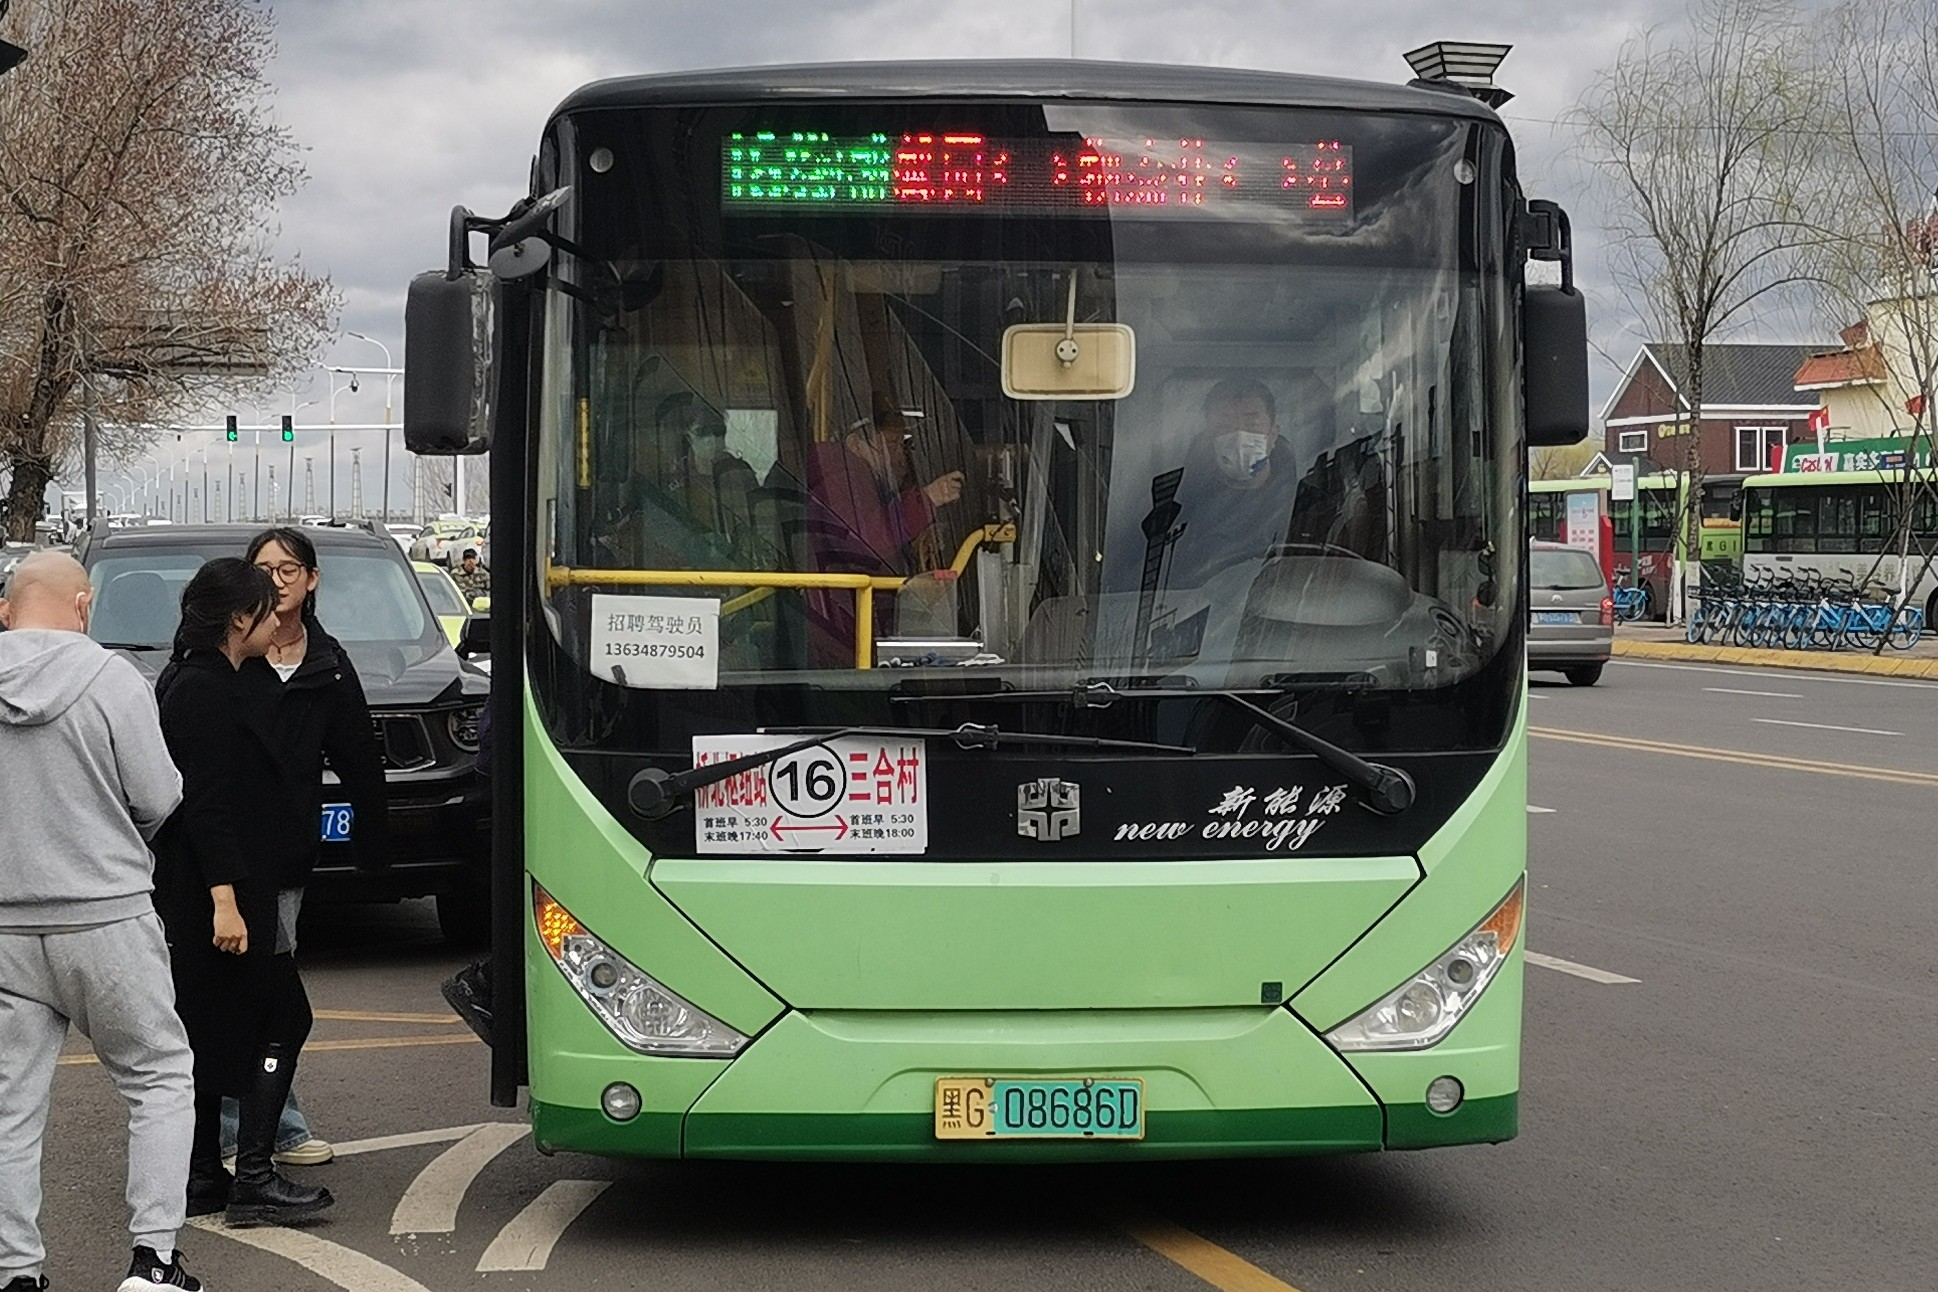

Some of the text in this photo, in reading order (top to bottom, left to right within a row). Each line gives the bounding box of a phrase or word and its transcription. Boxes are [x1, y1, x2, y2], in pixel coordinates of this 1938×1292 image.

[607, 613, 703, 635] 招聘驾驶员
[605, 643, 705, 659] 13634879504
[776, 760, 836, 802] 16
[848, 746, 919, 805] 三合村
[1208, 783, 1349, 820] 新能源
[321, 809, 351, 835] 78
[703, 816, 768, 829] 首班早 5:30
[849, 814, 915, 826] 首班早 5:30
[1113, 817, 1327, 851] new energy
